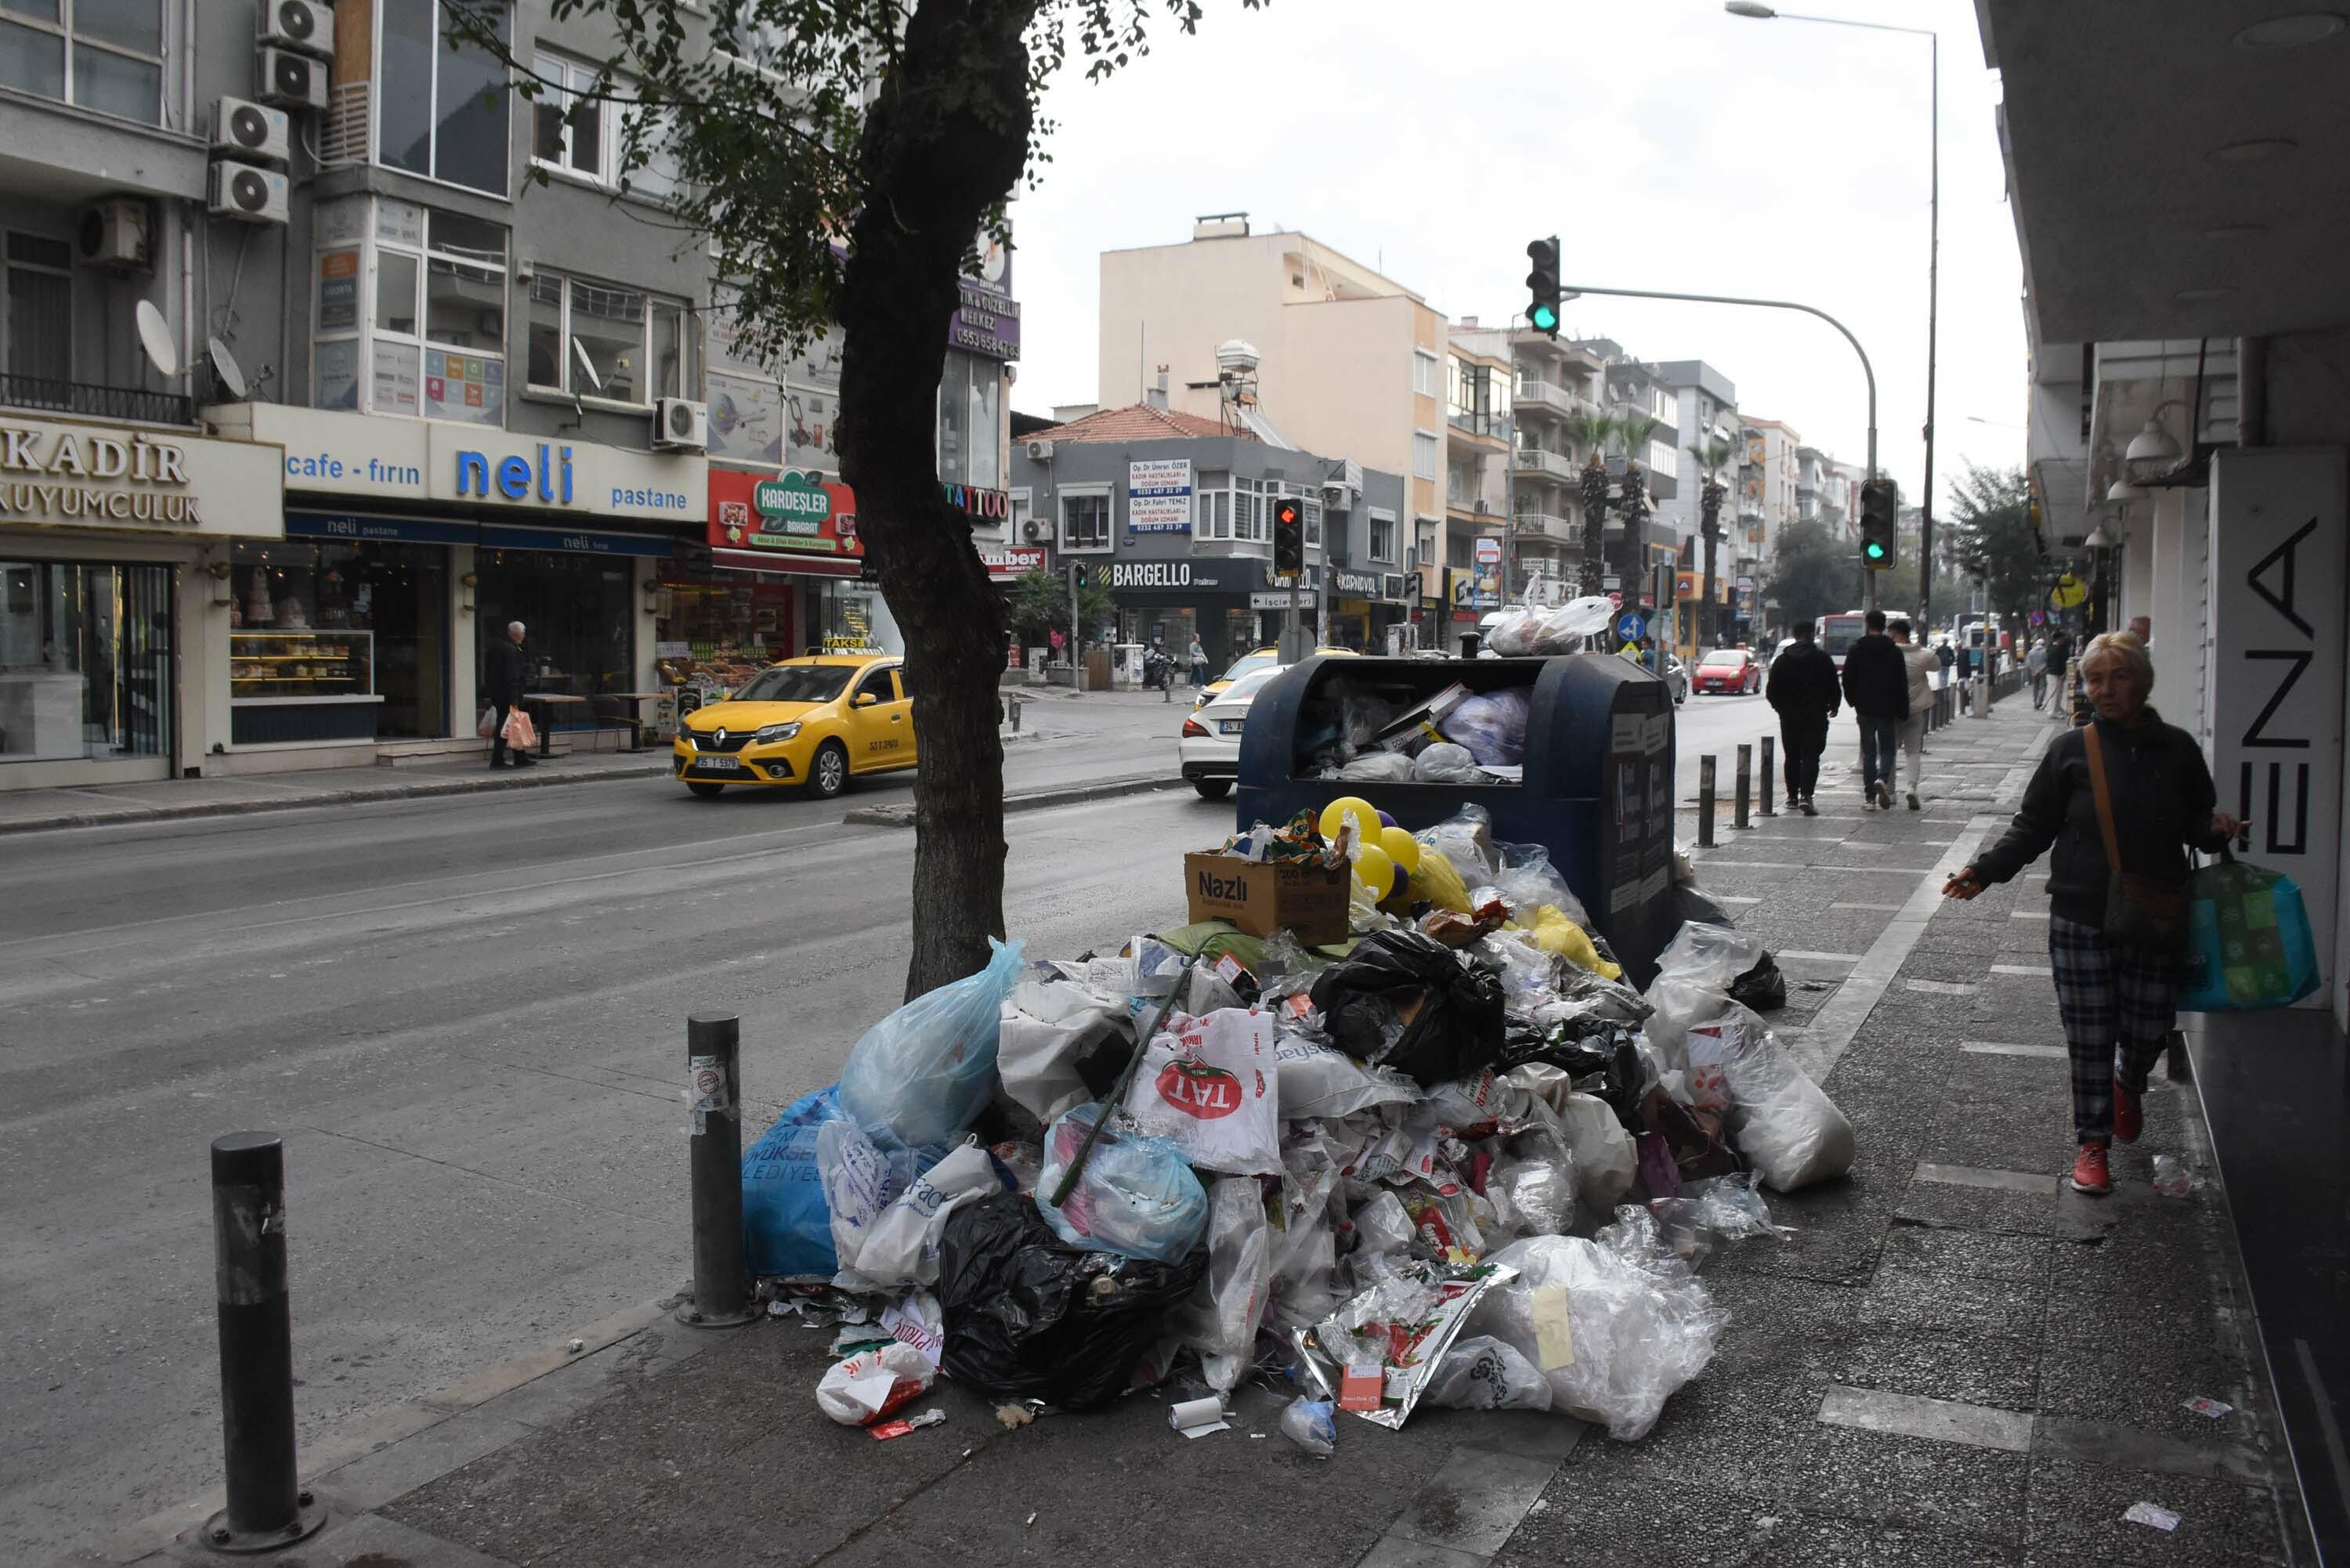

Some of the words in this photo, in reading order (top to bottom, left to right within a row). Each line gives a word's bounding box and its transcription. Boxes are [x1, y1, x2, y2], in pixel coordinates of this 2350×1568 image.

[2, 428, 189, 484] KADİR
[287, 453, 343, 479] cafe
[369, 459, 420, 485] fırın
[456, 443, 573, 503] neli
[611, 486, 686, 510] pastane
[761, 488, 827, 515] KARDEŞLER
[944, 482, 1008, 518] TATTOO
[327, 518, 356, 535] neli
[786, 520, 819, 534] BAHARAT
[563, 533, 589, 550] neli
[980, 550, 1041, 565] mber
[1113, 564, 1191, 587] BARGELLO
[1341, 574, 1376, 594] KARNAVAL
[1199, 871, 1247, 902] Nazlı
[1167, 1072, 1231, 1108] TAT
